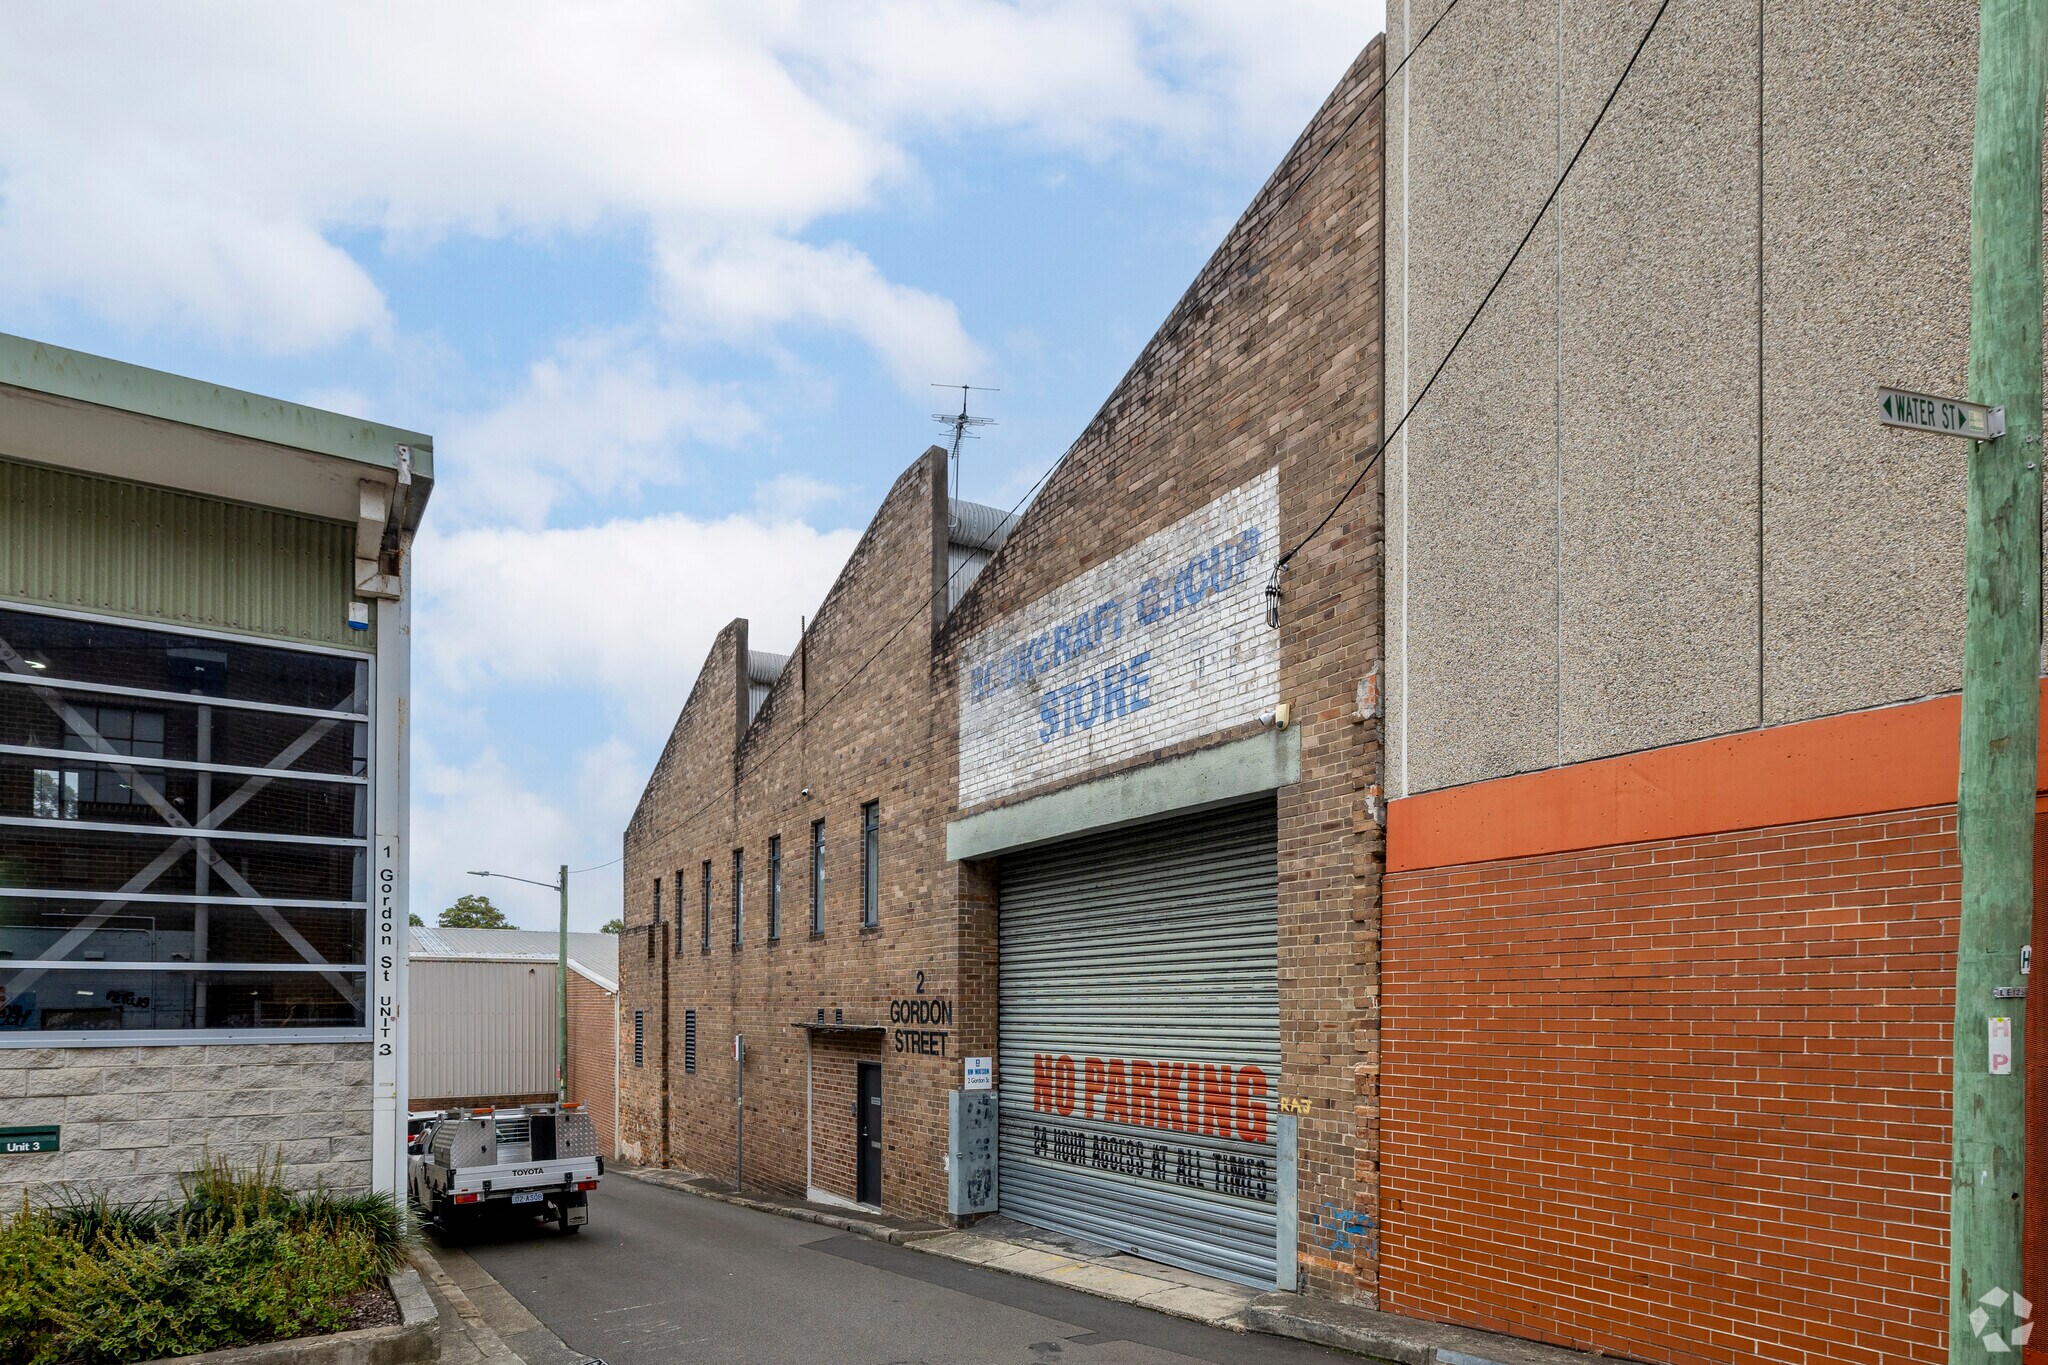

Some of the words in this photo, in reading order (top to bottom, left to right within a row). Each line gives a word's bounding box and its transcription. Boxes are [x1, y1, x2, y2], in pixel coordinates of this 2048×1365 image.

[1895, 394, 1936, 427] WATER
[1942, 403, 1956, 430] ST
[1039, 652, 1150, 743] STORE
[384, 846, 391, 858] 1
[380, 869, 393, 945] Gordon
[381, 956, 392, 982] St
[916, 970, 925, 994] 2
[380, 996, 391, 1038] UNIT
[890, 1000, 953, 1026] GORDON
[379, 1044, 392, 1056] 3
[895, 1029, 949, 1056] STREET
[1993, 1054, 2009, 1071] P
[1033, 1053, 1076, 1117] NO
[1084, 1056, 1268, 1143] PARKING
[7, 1142, 30, 1152] Unit
[32, 1142, 40, 1151] 3
[512, 1167, 543, 1177] TOYOTA
[1033, 1126, 1048, 1156] 24
[1053, 1128, 1086, 1165] HOUR
[1091, 1134, 1144, 1176] ACCESS
[1151, 1144, 1168, 1181] AT
[1175, 1149, 1204, 1188] ALL
[1212, 1153, 1268, 1200] TIMES
